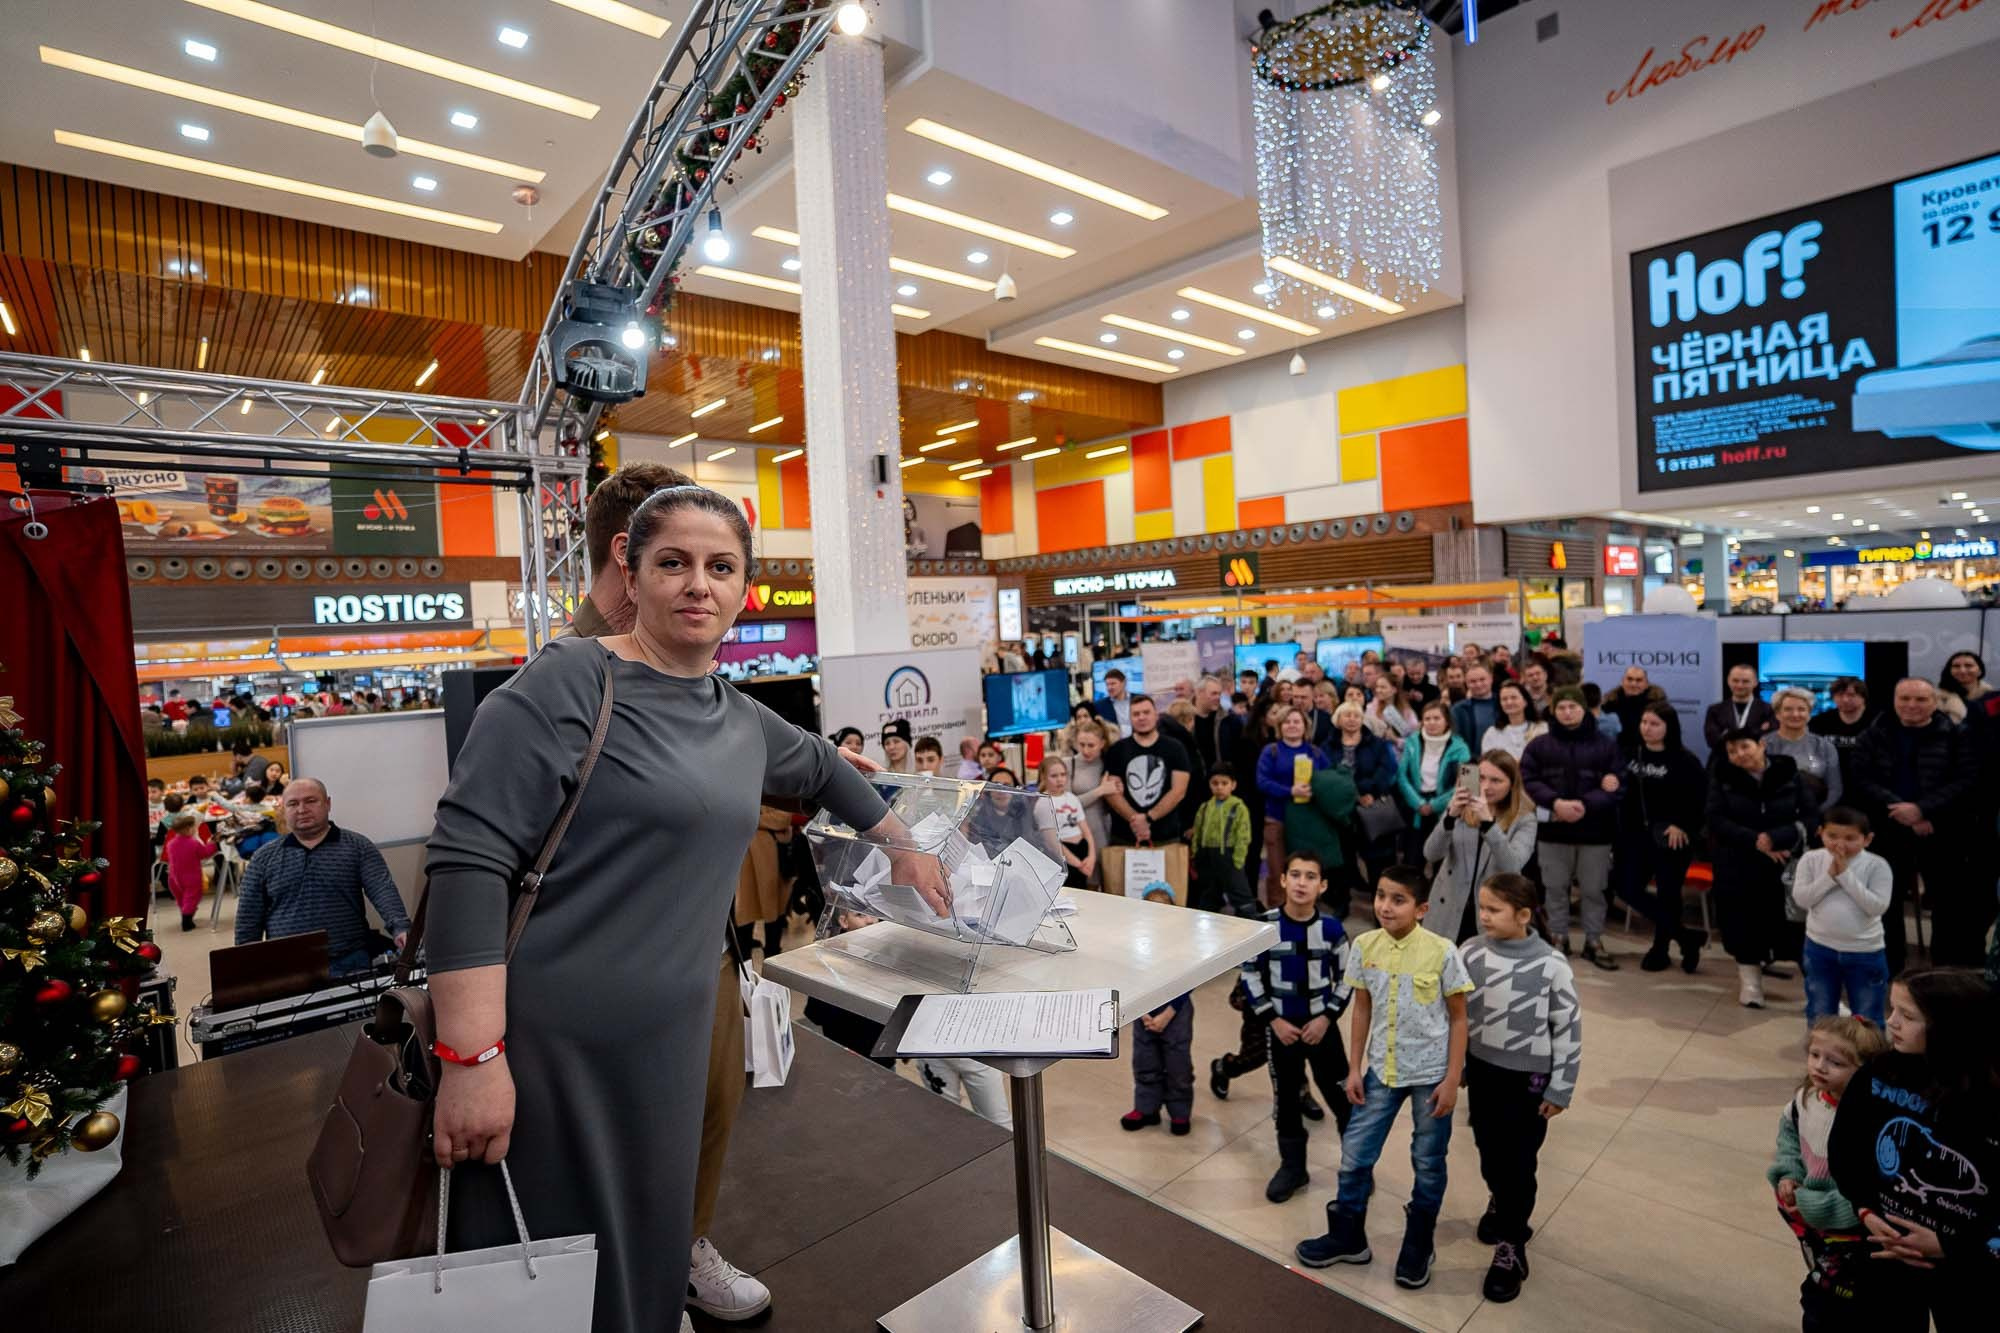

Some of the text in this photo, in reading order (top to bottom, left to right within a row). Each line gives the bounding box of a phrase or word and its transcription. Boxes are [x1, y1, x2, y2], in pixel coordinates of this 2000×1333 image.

[1606, 24, 1766, 104] Люблю
[1923, 214, 1975, 248] 12
[1651, 311, 1829, 372] ЧЁРНАЯ
[1652, 337, 1877, 404] ПЯТНИЦА
[1668, 453, 1716, 473] этаж
[1721, 446, 1787, 465] hoff.ru
[108, 471, 178, 487] ВКУСНО
[1127, 569, 1177, 589] ТОЧКА
[314, 592, 464, 624] ROSTIC'S
[912, 631, 958, 647] СКОРО
[1598, 649, 1700, 666] ИСТОРИЯ
[879, 706, 939, 722] ГУДВИЛЛ
